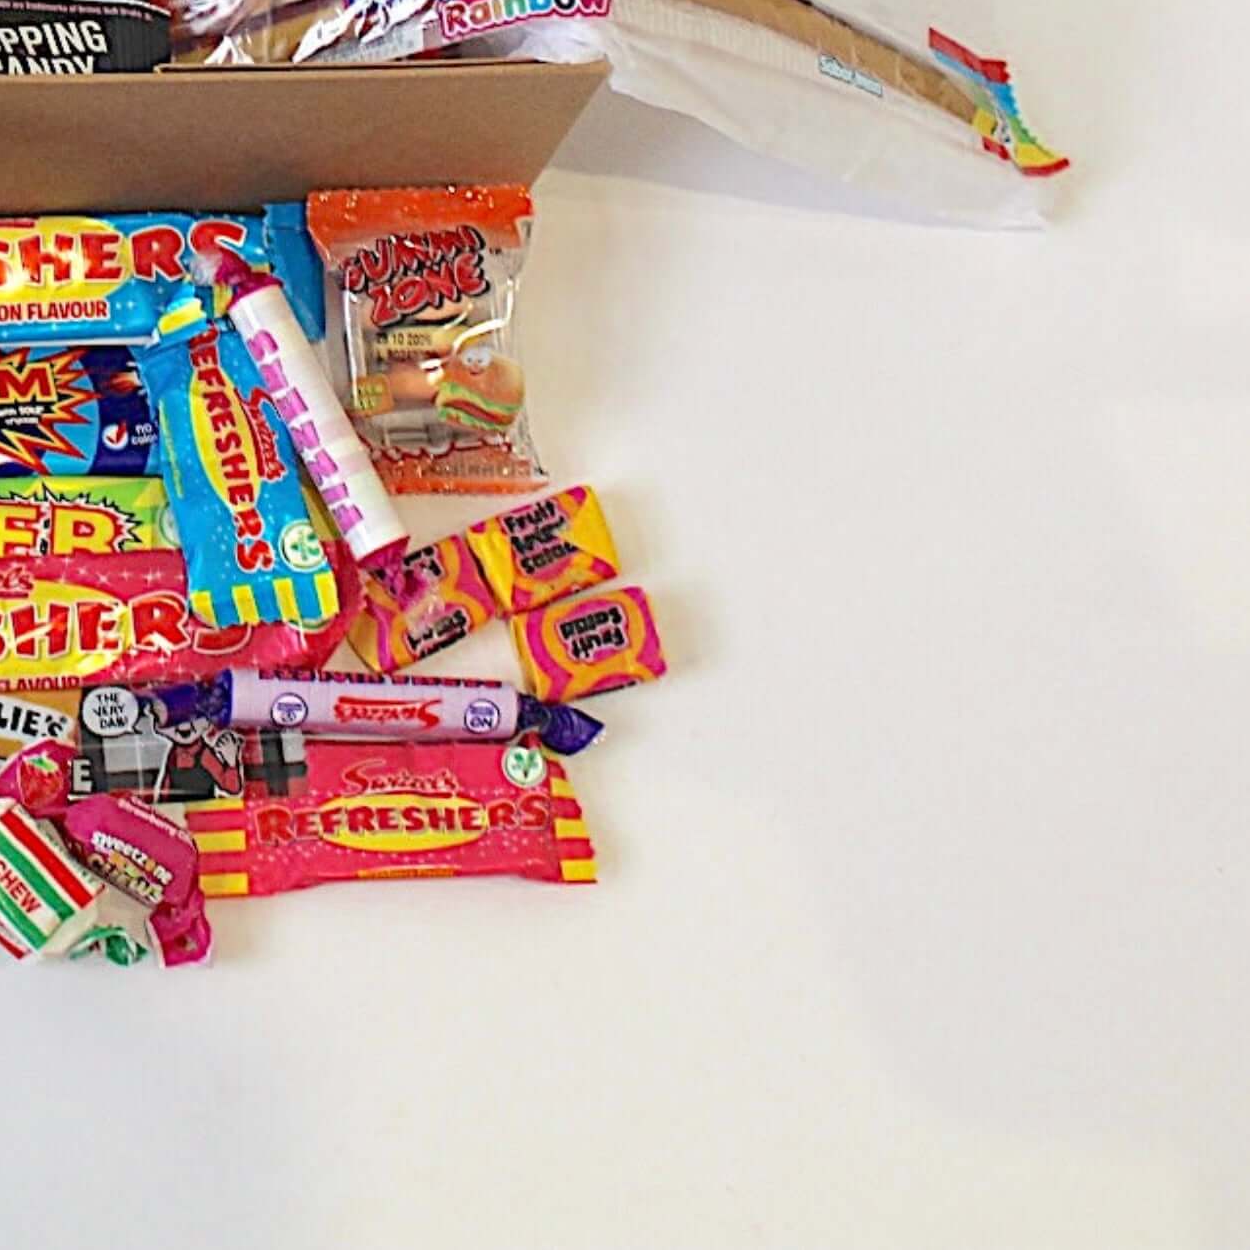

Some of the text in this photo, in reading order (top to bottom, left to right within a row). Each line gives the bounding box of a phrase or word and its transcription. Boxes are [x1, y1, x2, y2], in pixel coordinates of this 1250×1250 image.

[369, 253, 490, 327] ZONE
[26, 299, 108, 322] FLAVOUR
[97, 693, 120, 702] THE
[92, 704, 124, 717] VERY
[256, 794, 549, 845] REFRESHERS
